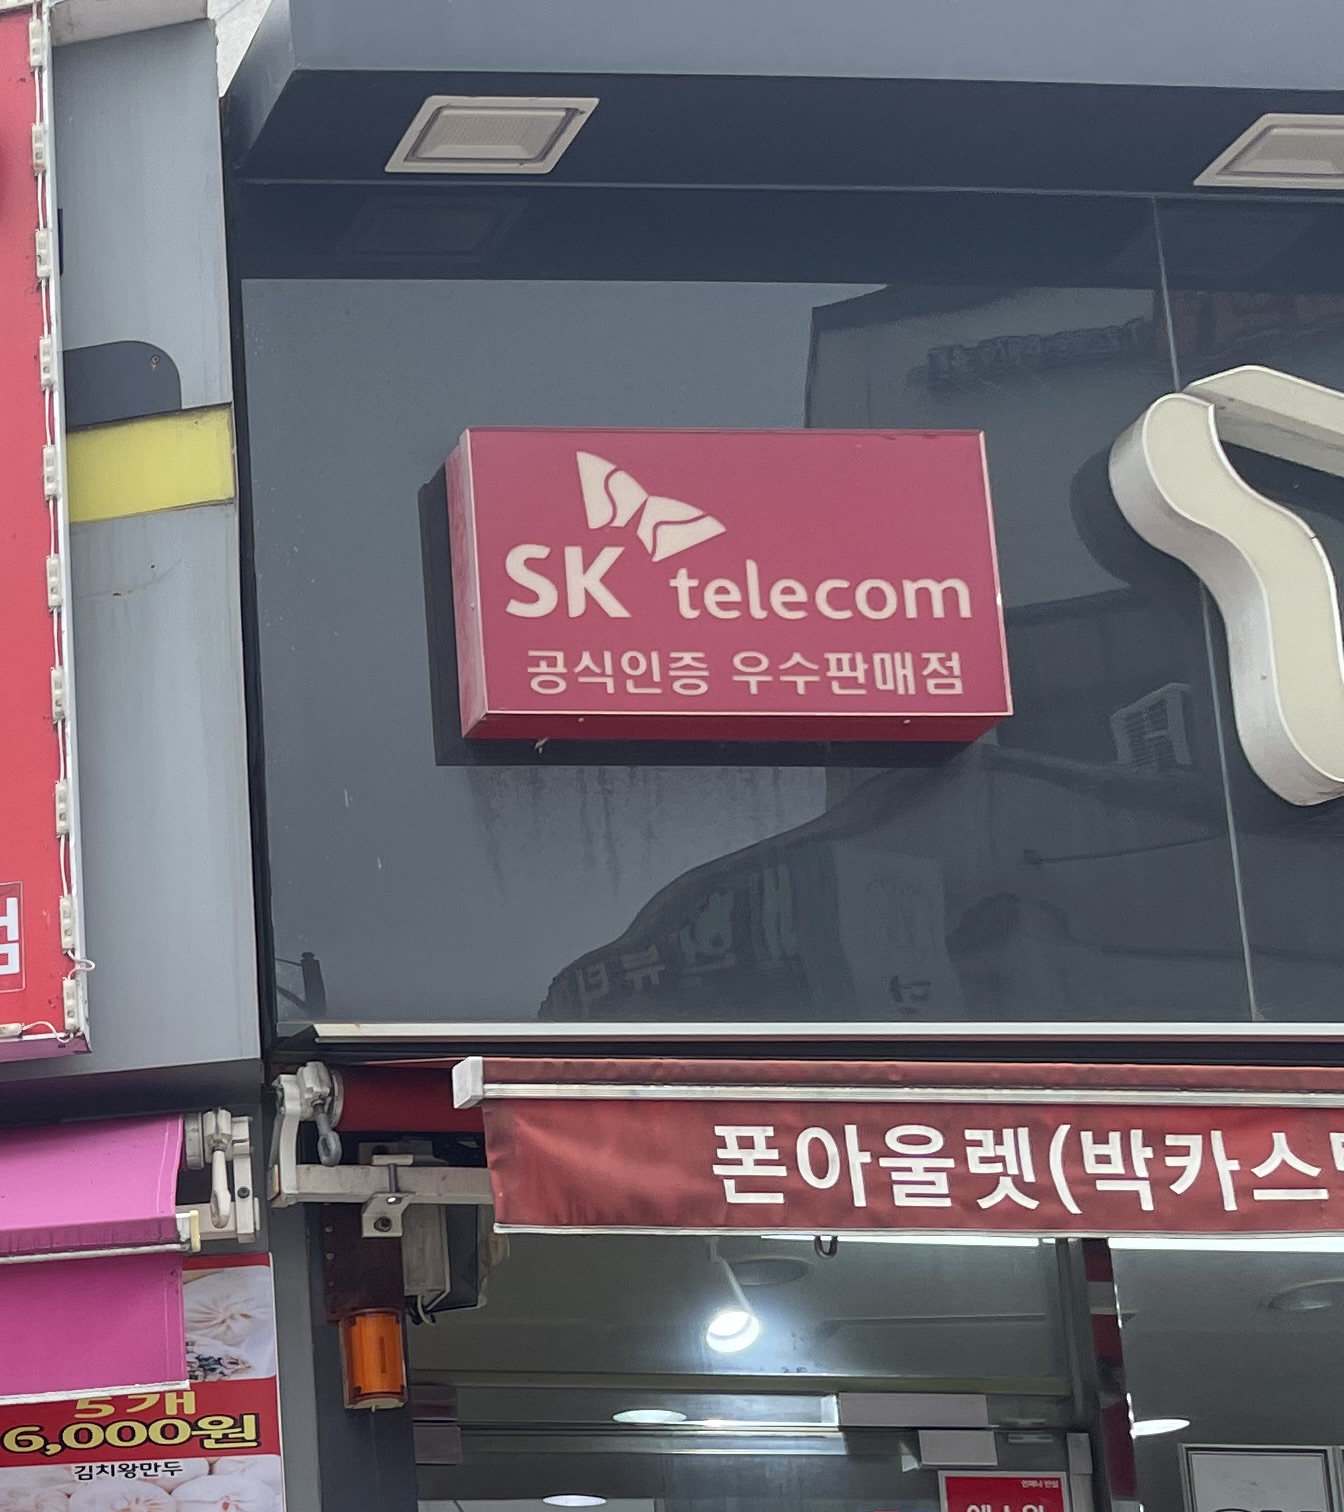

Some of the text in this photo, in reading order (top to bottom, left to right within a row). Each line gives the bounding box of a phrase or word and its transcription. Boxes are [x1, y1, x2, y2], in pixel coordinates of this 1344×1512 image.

[504, 543, 973, 621] SK telecom
[525, 648, 965, 697] 공식인증 우수판매점
[712, 1121, 1344, 1215] 폰아울렛(박카스
[74, 1391, 196, 1419] 5개
[1, 1413, 260, 1457] 6,000원
[74, 1461, 183, 1481] 김치왕만두
